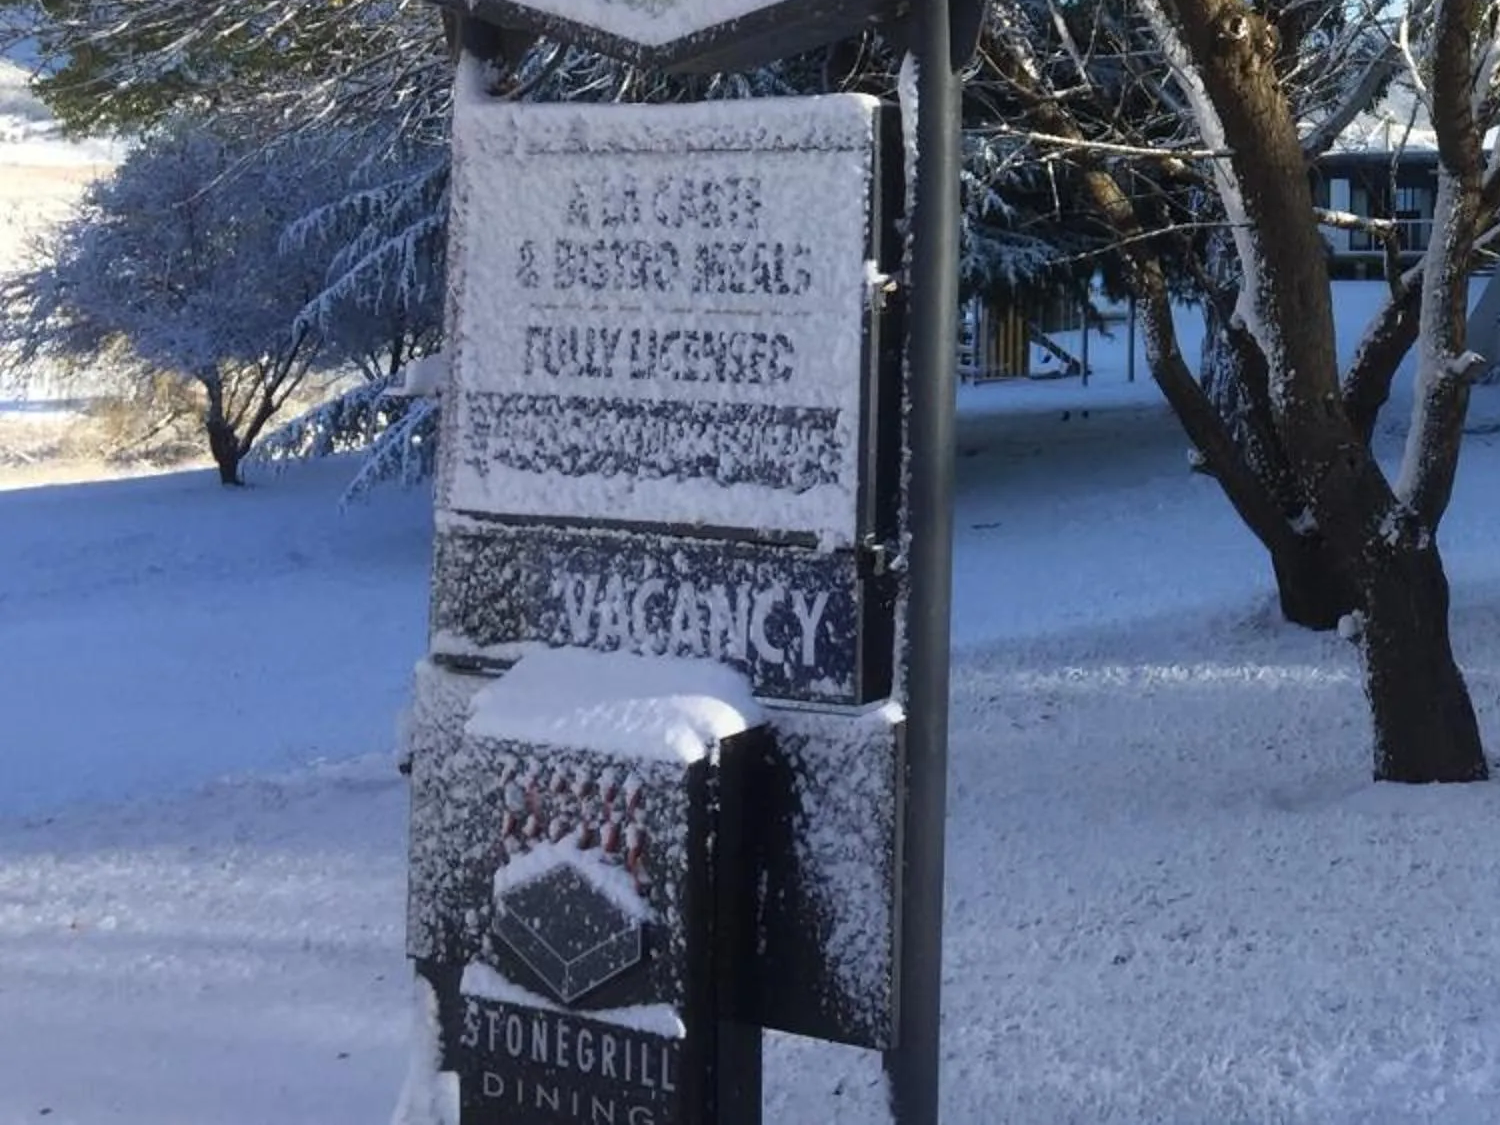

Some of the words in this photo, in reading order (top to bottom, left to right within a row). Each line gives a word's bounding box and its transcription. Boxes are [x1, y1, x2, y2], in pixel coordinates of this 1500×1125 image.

[554, 239, 679, 293] BISTRO
[692, 242, 812, 295] MEALS
[524, 326, 622, 379] FULLY
[564, 574, 827, 666] VACANCY
[461, 1003, 676, 1091] STONEGRILL
[483, 1071, 656, 1125] DINING
